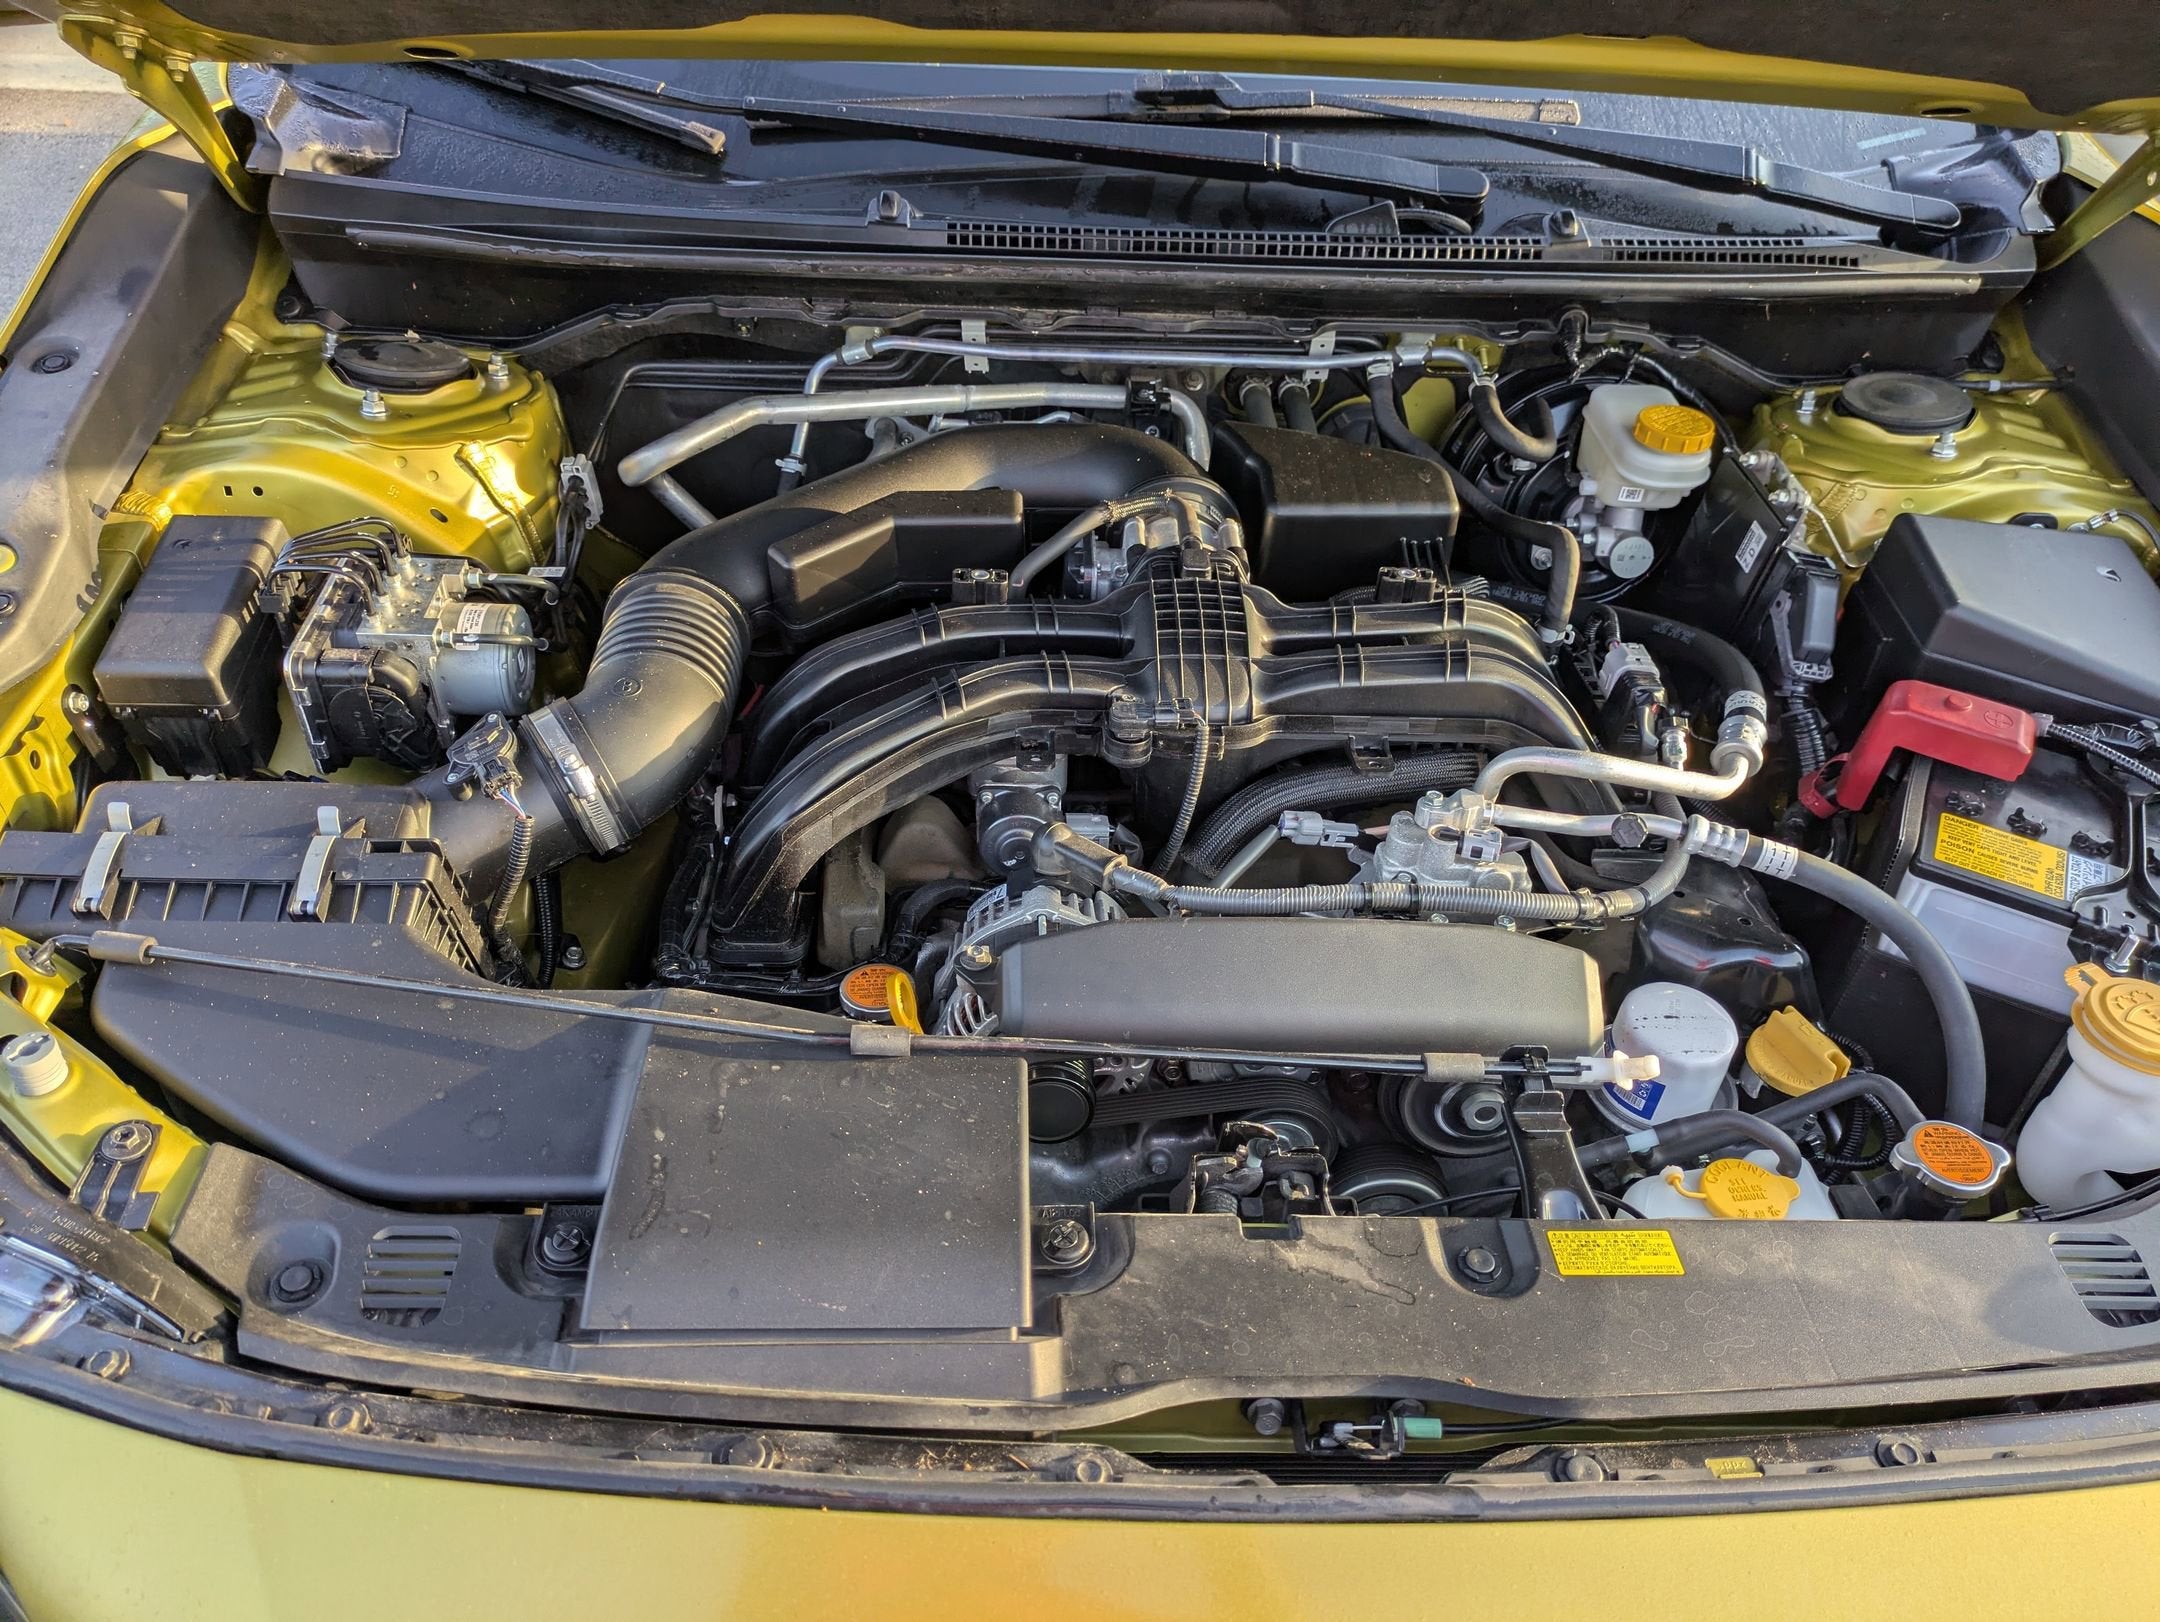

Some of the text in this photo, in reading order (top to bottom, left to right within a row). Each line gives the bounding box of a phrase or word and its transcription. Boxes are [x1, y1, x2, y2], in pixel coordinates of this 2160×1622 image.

[1943, 814, 1978, 830] DANGER
[1940, 838, 1974, 854] POISON
[1976, 851, 1997, 861] CAUSES
[1999, 858, 2018, 868] SEVERE
[1944, 856, 1957, 864] KEEP
[1958, 860, 1969, 868] OUT
[1947, 834, 2036, 867] KEEP VENT CAPS TIGHT AND LEVEL
[1705, 1160, 1770, 1184] COOLANT
